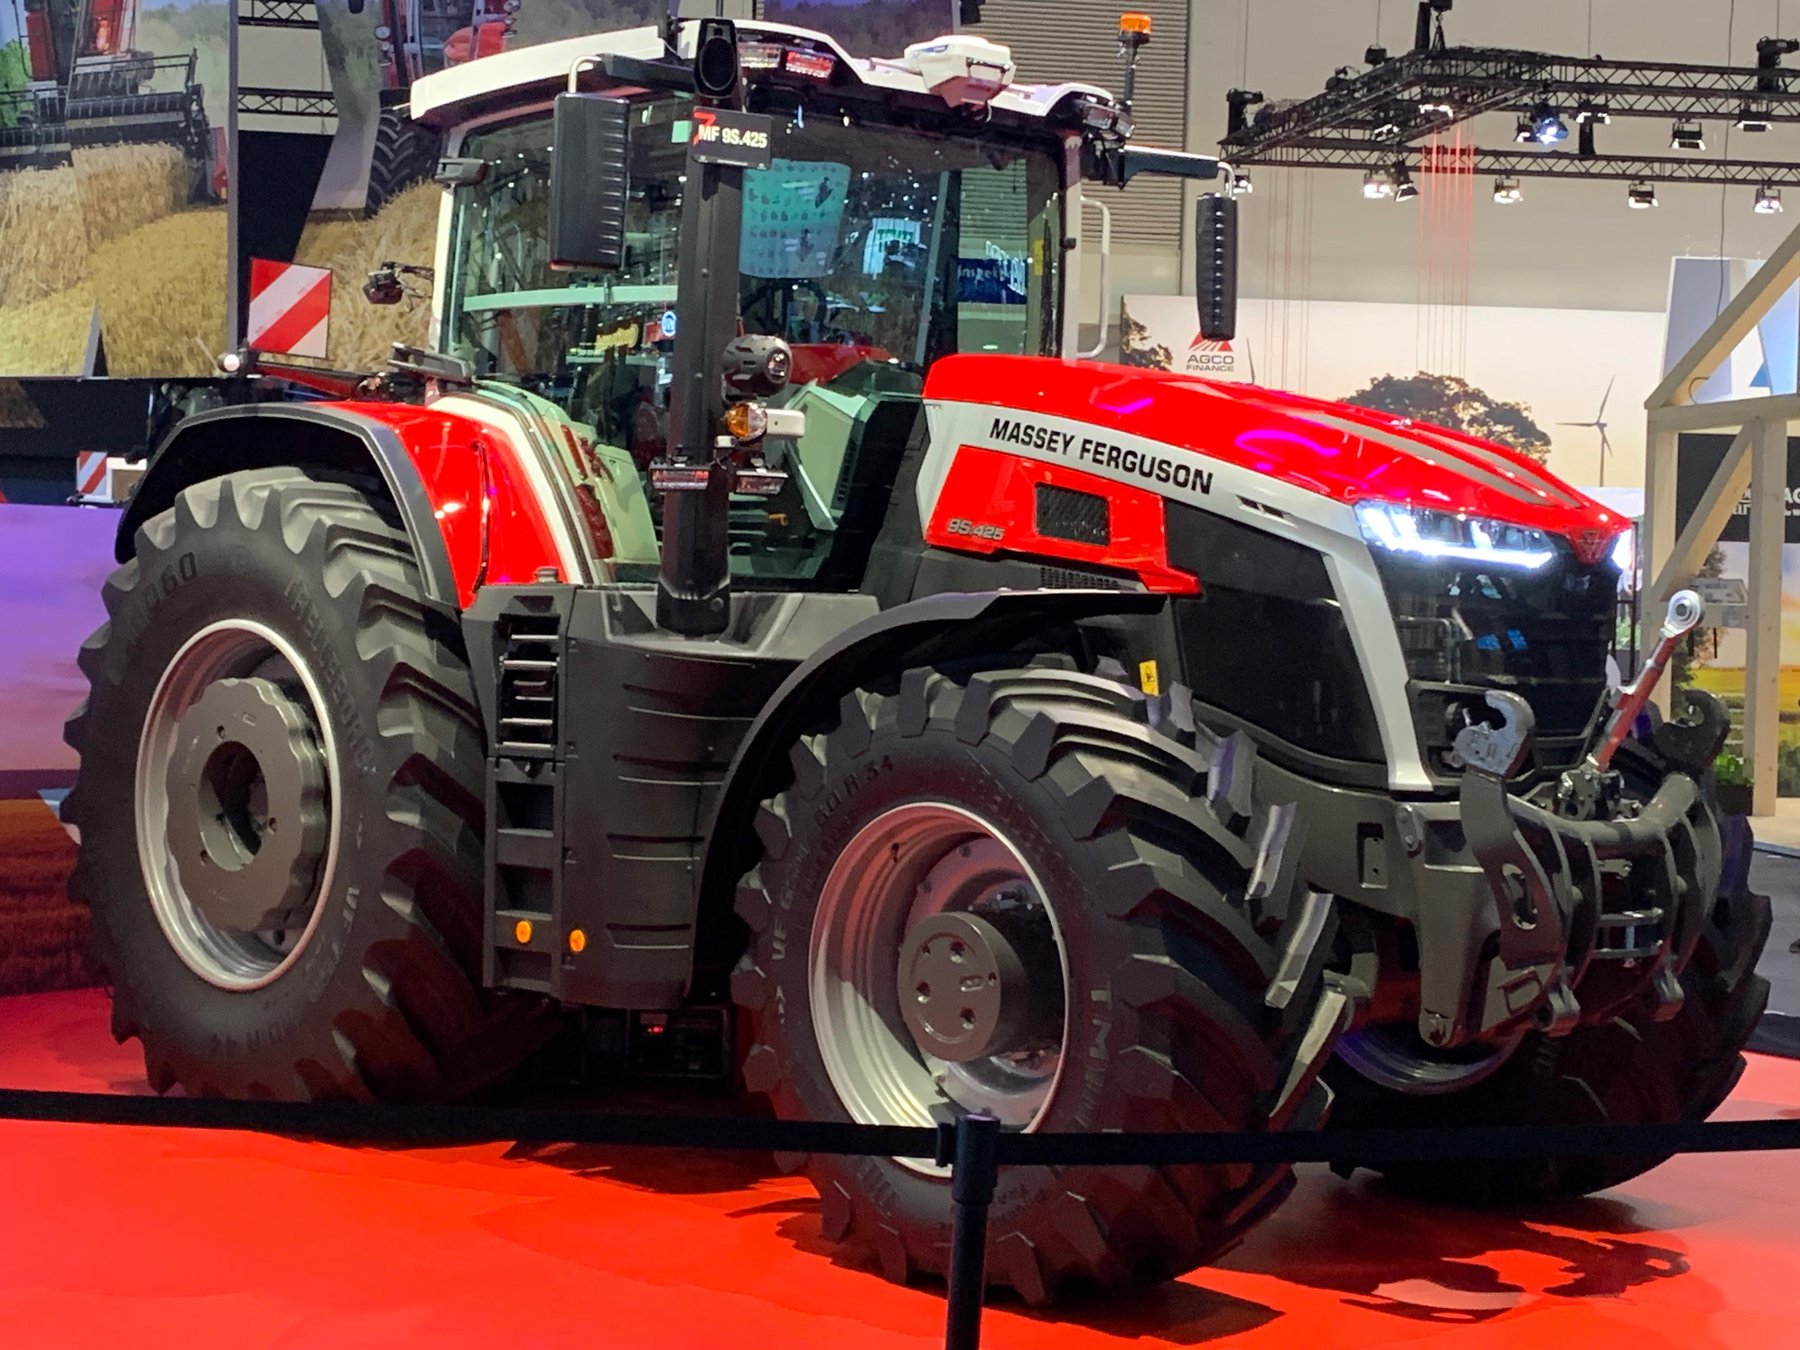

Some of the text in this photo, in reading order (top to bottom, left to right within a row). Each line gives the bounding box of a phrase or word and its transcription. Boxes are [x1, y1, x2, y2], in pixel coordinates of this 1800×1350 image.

[698, 124, 768, 149] MF 9S.425
[1187, 354, 1234, 365] AGCO
[989, 418, 1214, 495] MASSEY FERGUSON
